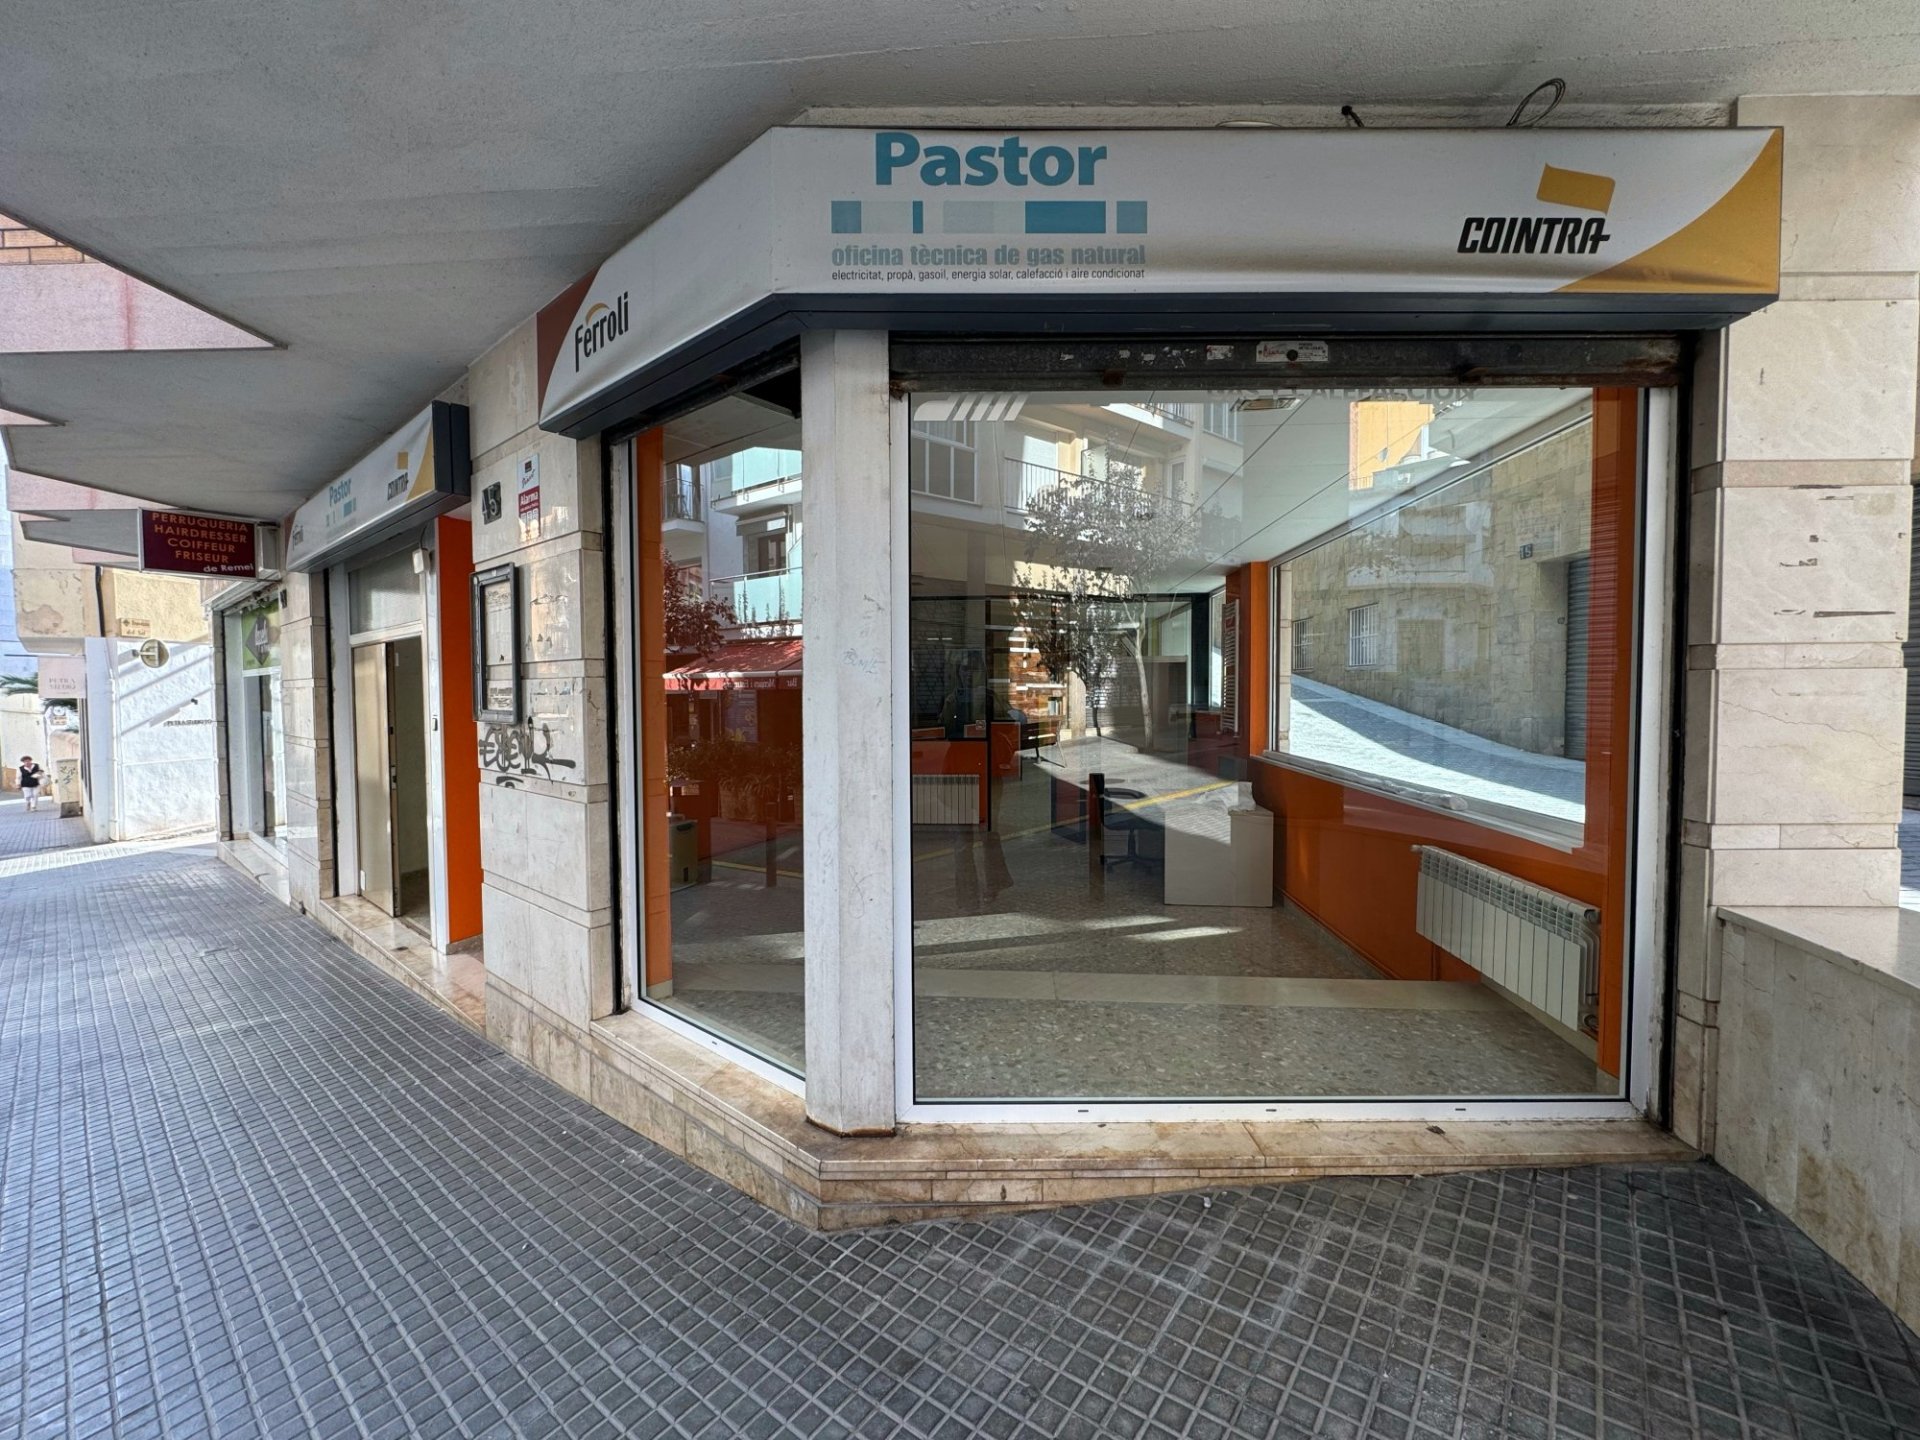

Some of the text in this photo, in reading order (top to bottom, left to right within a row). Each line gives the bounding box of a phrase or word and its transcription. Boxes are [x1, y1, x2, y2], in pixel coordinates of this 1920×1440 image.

[875, 132, 1108, 187] Pastor
[1457, 216, 1611, 255] COINTRA
[832, 244, 1146, 267] oficina tècnica de gas natural
[832, 269, 884, 282] electricitat,
[887, 269, 916, 282] propà,
[918, 269, 948, 282] gasoil,
[951, 270, 987, 282] energia
[989, 269, 1014, 281] solar,
[1016, 269, 1064, 281] calefacció
[1071, 269, 1089, 280] aire
[1091, 269, 1145, 280] condicionat
[574, 291, 629, 373] Ferroli
[329, 478, 352, 507] Pastor
[482, 485, 497, 521] 45
[152, 512, 248, 533] PERRUQUERIA
[154, 524, 247, 543] HAIRDRESSER
[167, 537, 236, 553] COIFFEUR
[175, 550, 229, 563] FRISEUR
[203, 565, 218, 573] de
